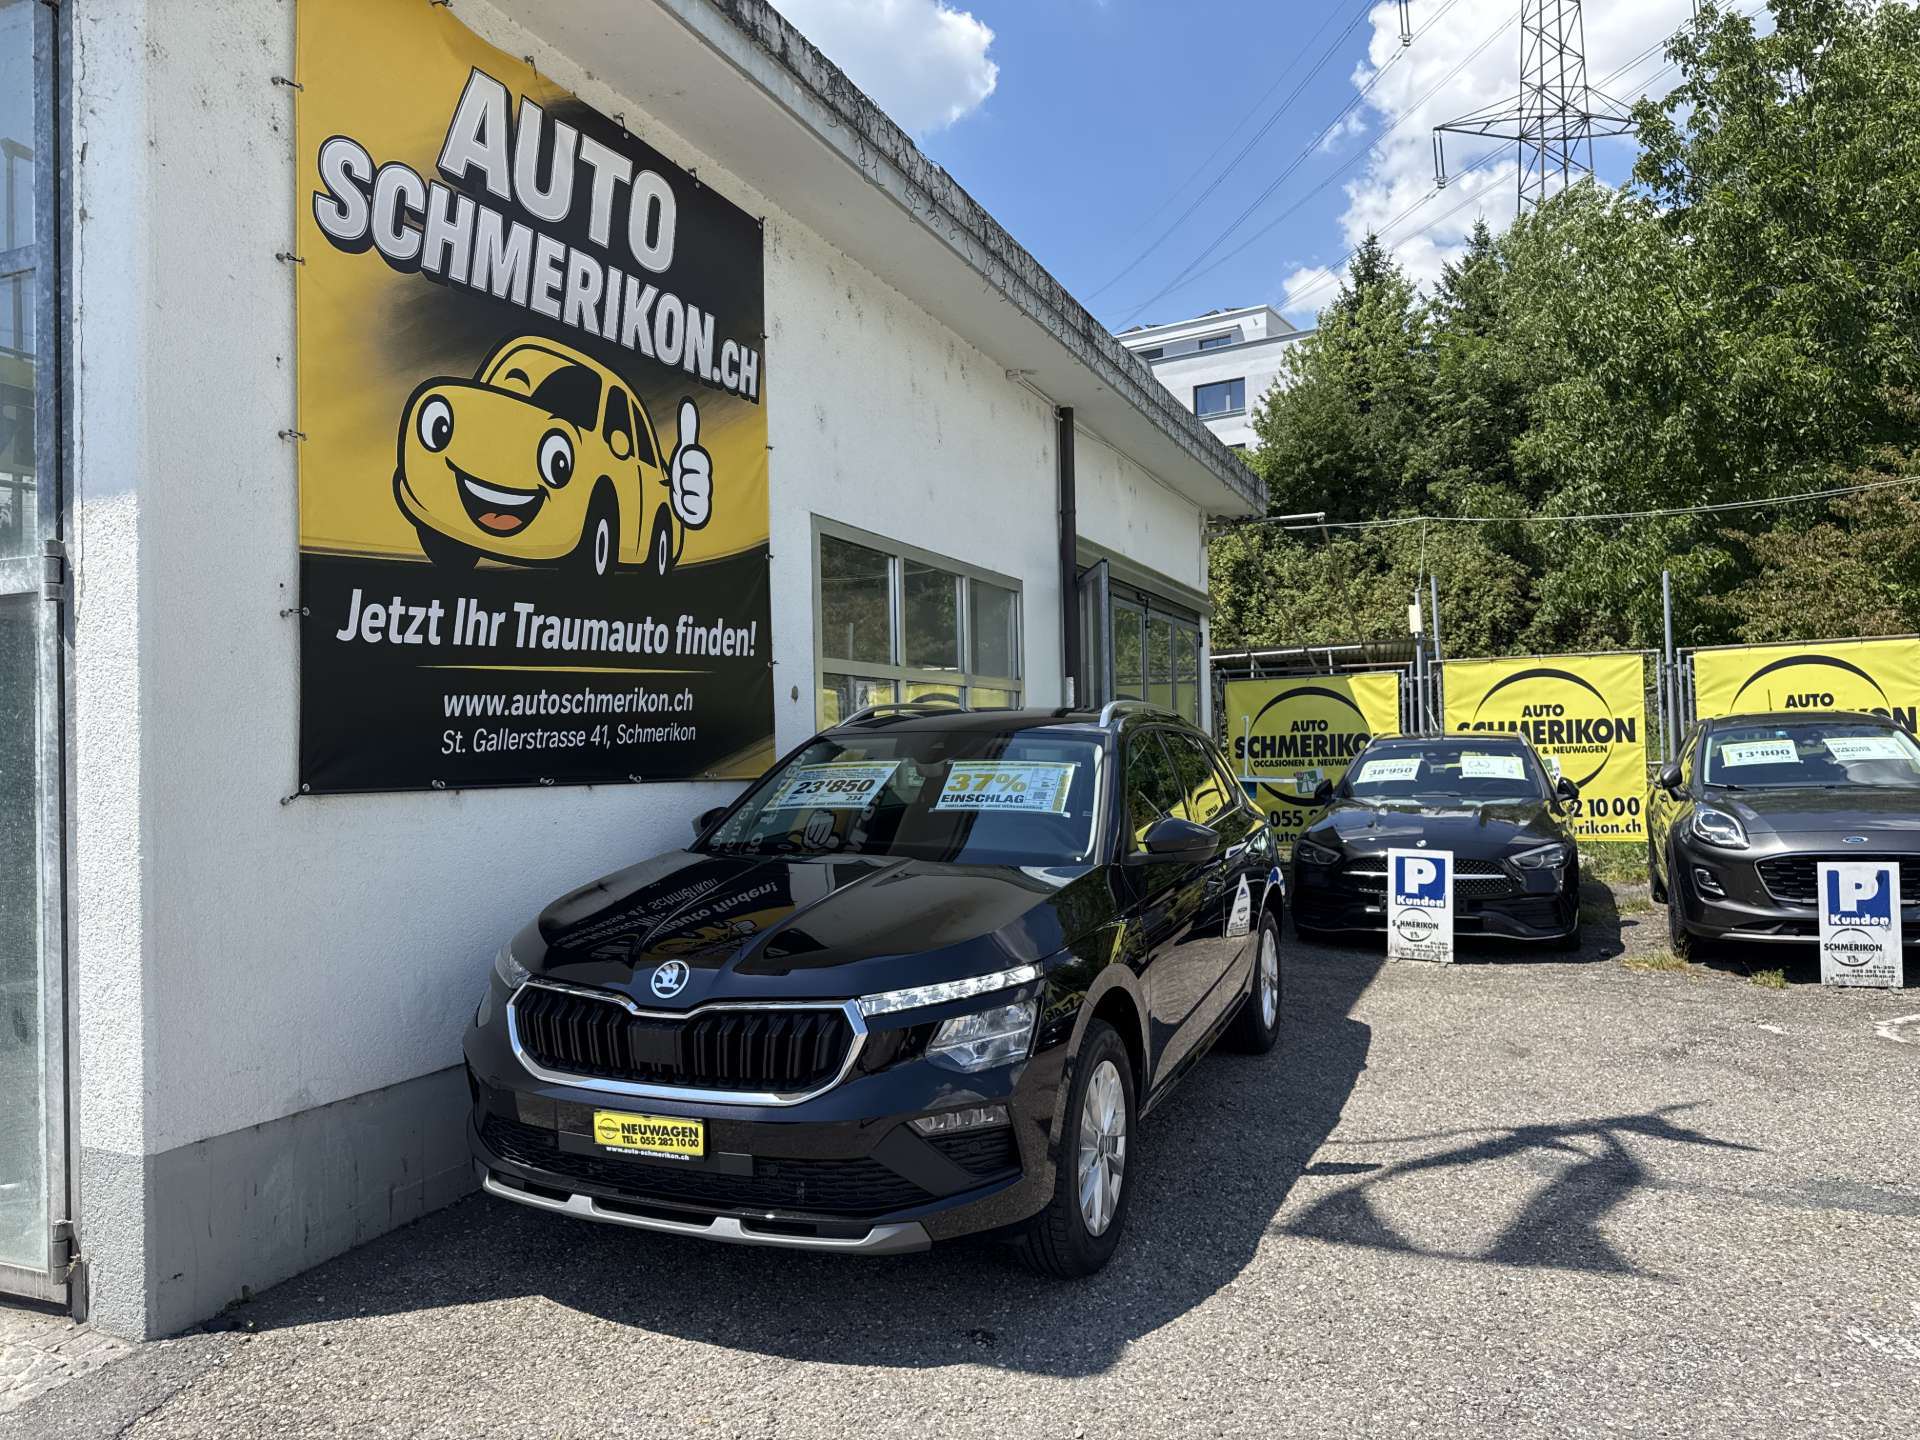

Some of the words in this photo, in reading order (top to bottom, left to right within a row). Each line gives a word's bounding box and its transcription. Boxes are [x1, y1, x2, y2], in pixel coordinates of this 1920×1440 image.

[437, 66, 677, 273] AUTO
[314, 136, 759, 398] SCHMERIKON.CH
[336, 589, 445, 645] Jetzt
[452, 598, 506, 647] Ihr
[513, 603, 669, 655] Traumauto
[676, 615, 757, 657] finden!
[444, 688, 693, 717] www.autoschmerikon.ch
[1785, 693, 1834, 708] AUTO
[1522, 704, 1564, 718] AUTO
[1290, 720, 1329, 733] AUTO
[441, 730, 467, 754] St.
[473, 727, 585, 752] Gallerstrasse
[590, 725, 611, 749] 41,
[616, 723, 696, 745] Schmerikon
[1234, 733, 1373, 759] SCHMERIKO
[1552, 745, 1608, 754] NEUWAGEN
[1254, 759, 1304, 767] OCCASIONEN
[792, 779, 875, 795] 23'850
[947, 773, 1027, 792] 37%
[940, 794, 1025, 804] EINSCHLAG
[1589, 799, 1608, 817] 10
[1612, 797, 1640, 817] 00
[1270, 810, 1304, 827] 055
[1404, 858, 1437, 894] P
[1397, 895, 1444, 907] Kunden
[1830, 914, 1889, 925] Kunden
[1824, 943, 1882, 952] SCHMERIKON
[621, 1123, 699, 1138] NEUWAGEN
[622, 1136, 637, 1144] TEL:
[640, 1137, 656, 1145] 055
[658, 1138, 674, 1146] 282
[676, 1138, 686, 1147] 10
[687, 1139, 699, 1147] 00
